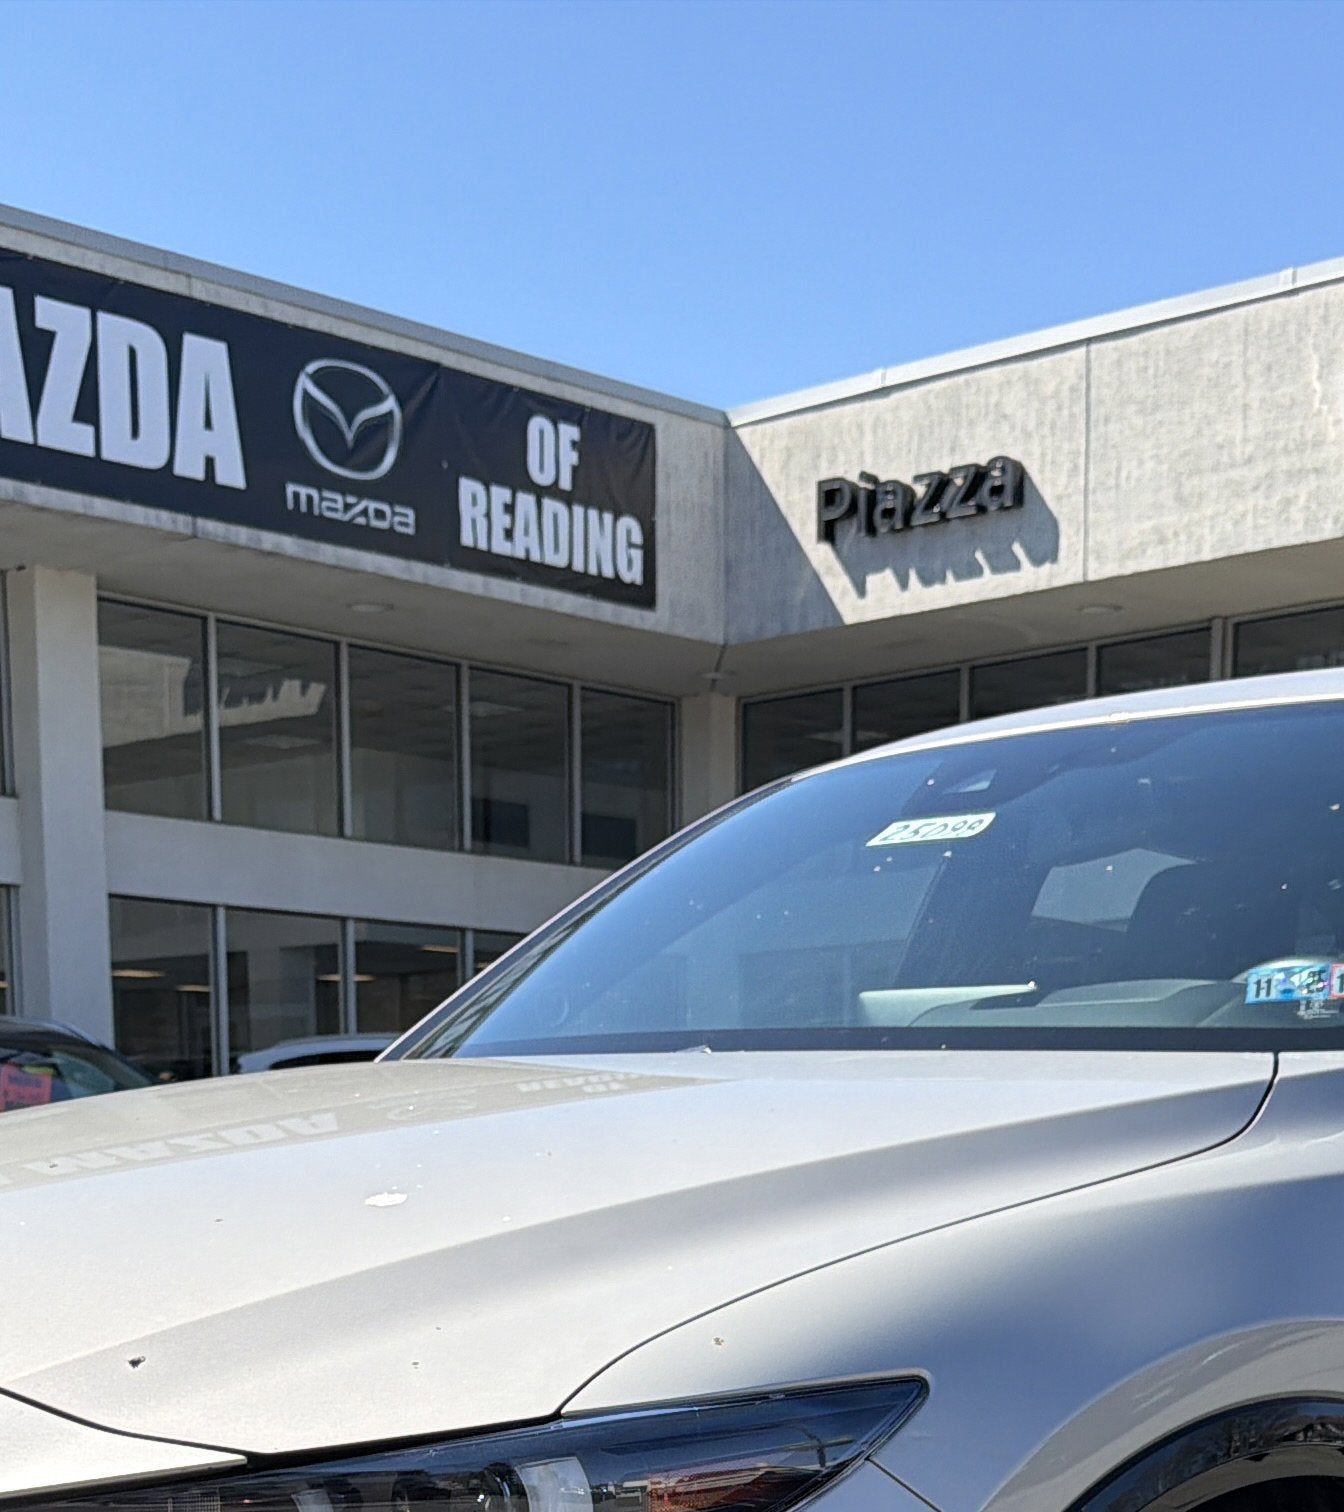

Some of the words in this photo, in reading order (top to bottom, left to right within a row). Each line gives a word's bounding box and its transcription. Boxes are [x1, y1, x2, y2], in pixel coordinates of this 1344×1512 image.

[524, 414, 580, 492] OF
[458, 475, 644, 586] READING
[816, 455, 1026, 545] Piazza
[1253, 977, 1273, 998] 11
